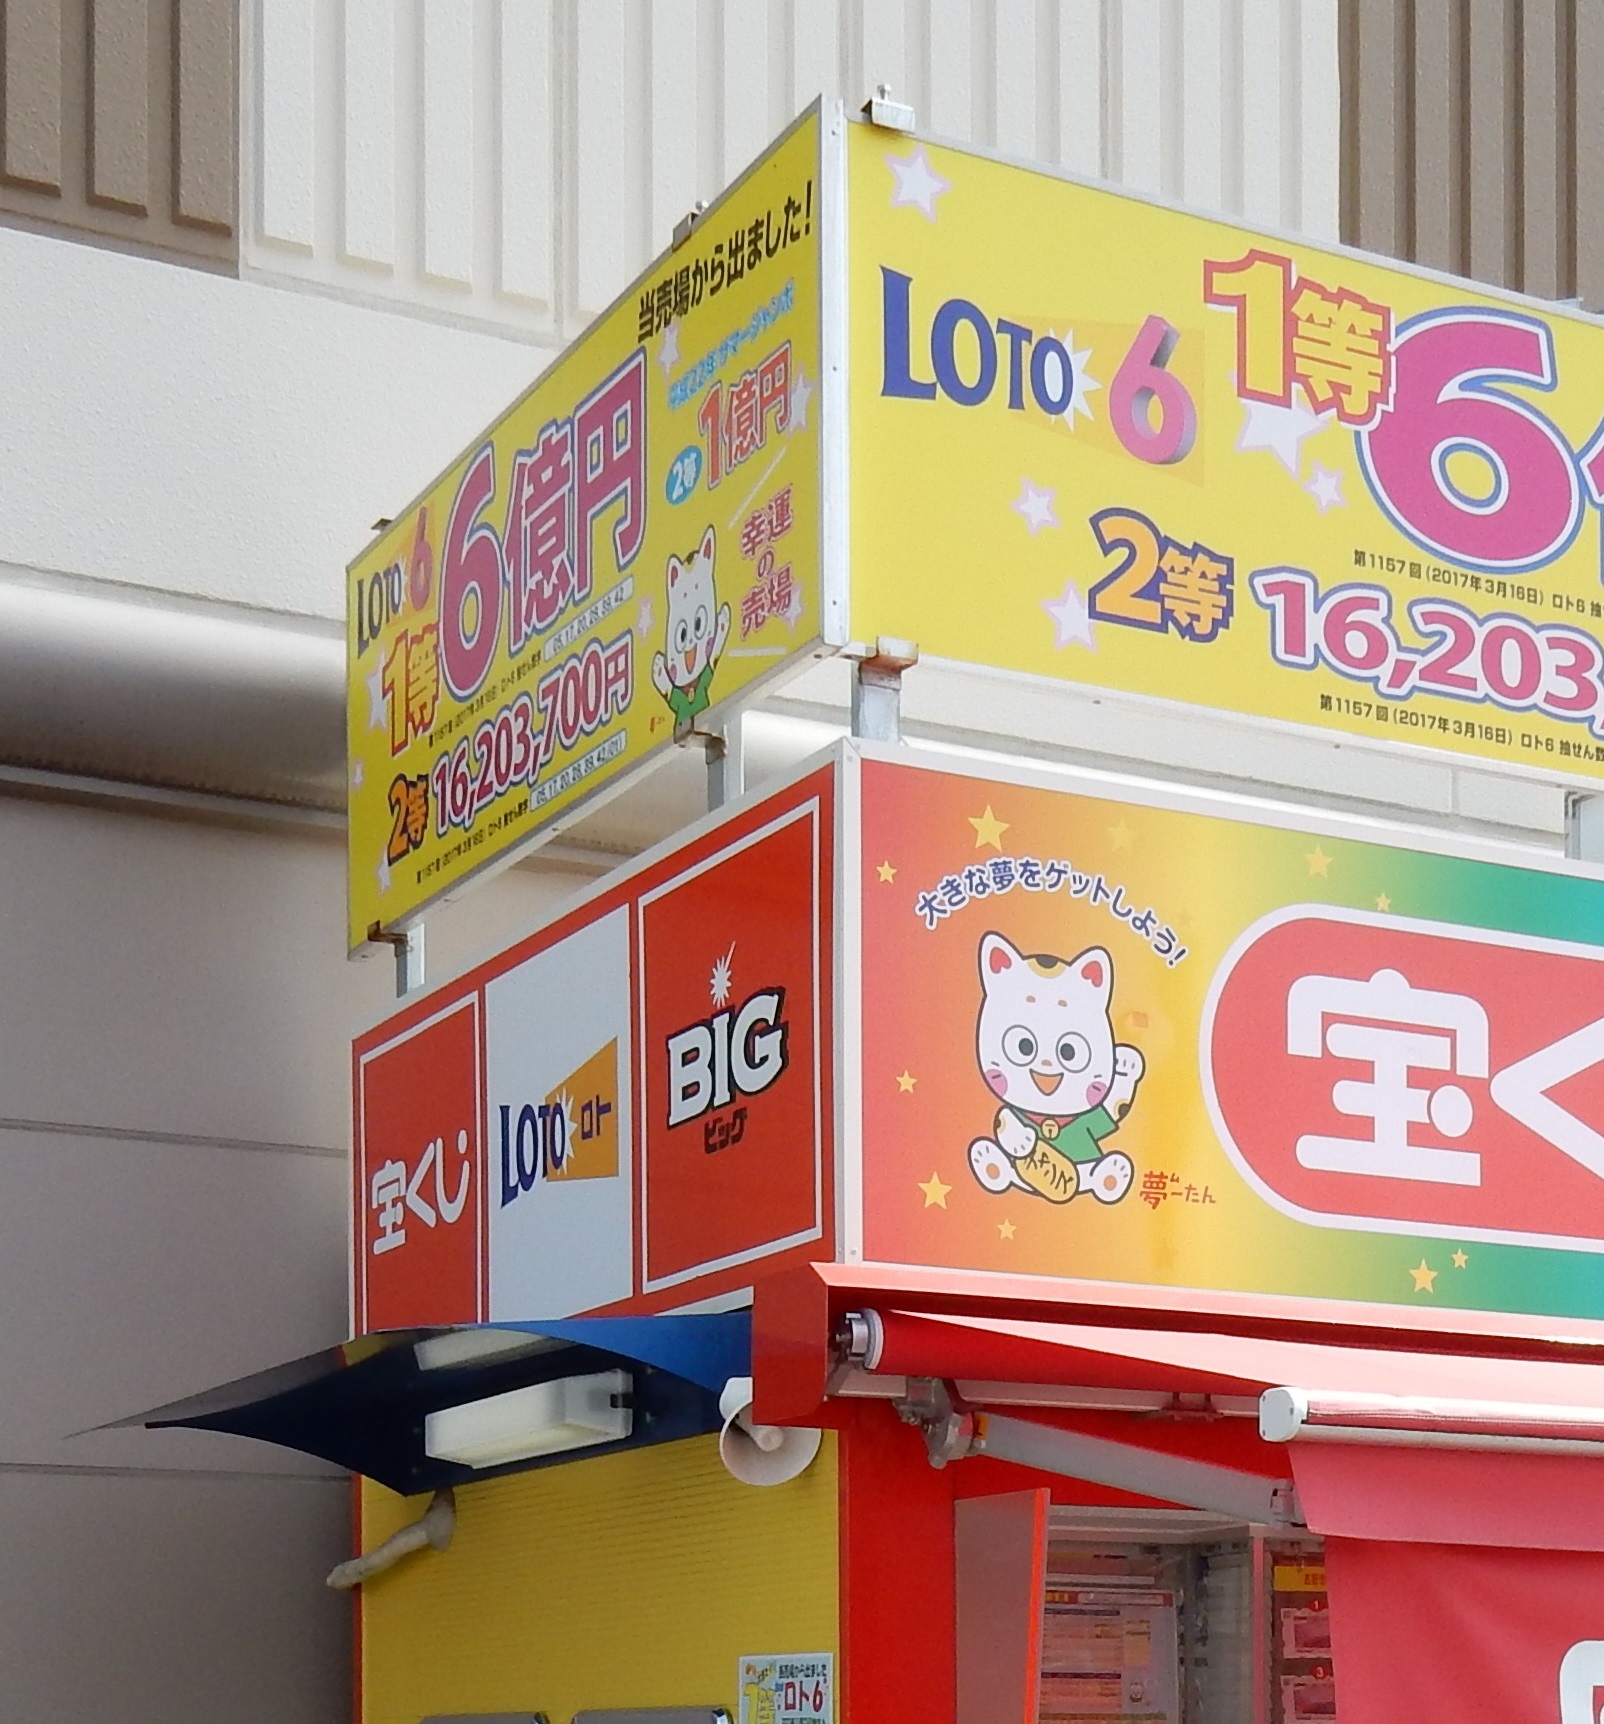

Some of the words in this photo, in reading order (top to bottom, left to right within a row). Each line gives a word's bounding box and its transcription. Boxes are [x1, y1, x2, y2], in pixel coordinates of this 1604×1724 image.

[637, 180, 813, 344] 当売場から出ました!
[880, 265, 1074, 417] LOTO
[1109, 315, 1197, 466] 6
[1203, 248, 1393, 430] 1等
[698, 339, 791, 491] 1億円
[356, 561, 402, 658] LOTO
[410, 506, 434, 611] 6
[440, 344, 648, 701] 6億円
[1088, 507, 1234, 644] 2等
[433, 628, 634, 838] 16,203,700円
[915, 855, 1190, 969] 大きな夢をゲットしよう!
[666, 985, 788, 1130] BIG
[704, 1107, 748, 1154] ビッグ
[372, 1128, 470, 1256] 宝くじ
[499, 1102, 567, 1209] LOTO
[580, 1093, 613, 1142] ロト
[784, 1680, 824, 1713] ロト6
